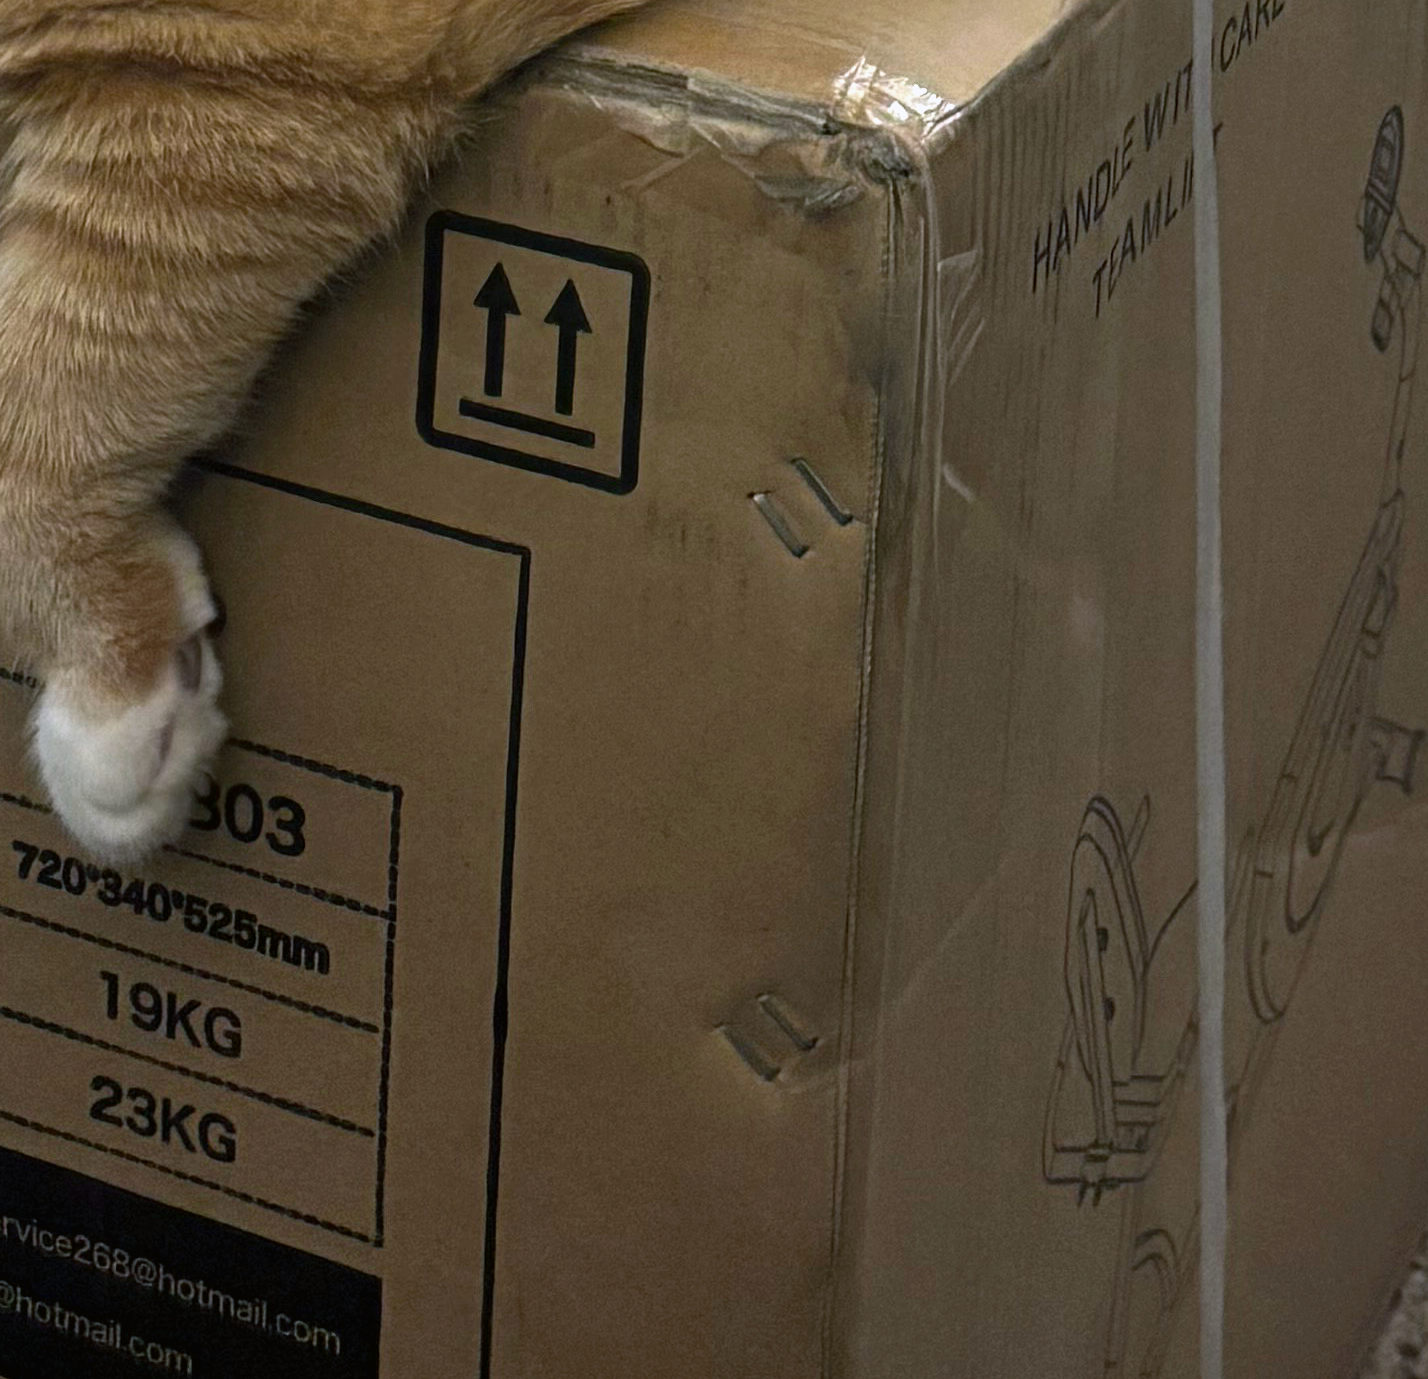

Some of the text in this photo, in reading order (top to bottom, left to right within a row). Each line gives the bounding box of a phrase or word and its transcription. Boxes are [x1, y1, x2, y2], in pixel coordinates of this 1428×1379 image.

[1032, 114, 1136, 295] HANDLE
[1143, 36, 1215, 153] WIT
[99, 970, 243, 1059] 19KG
[90, 1074, 237, 1164] 23KG
